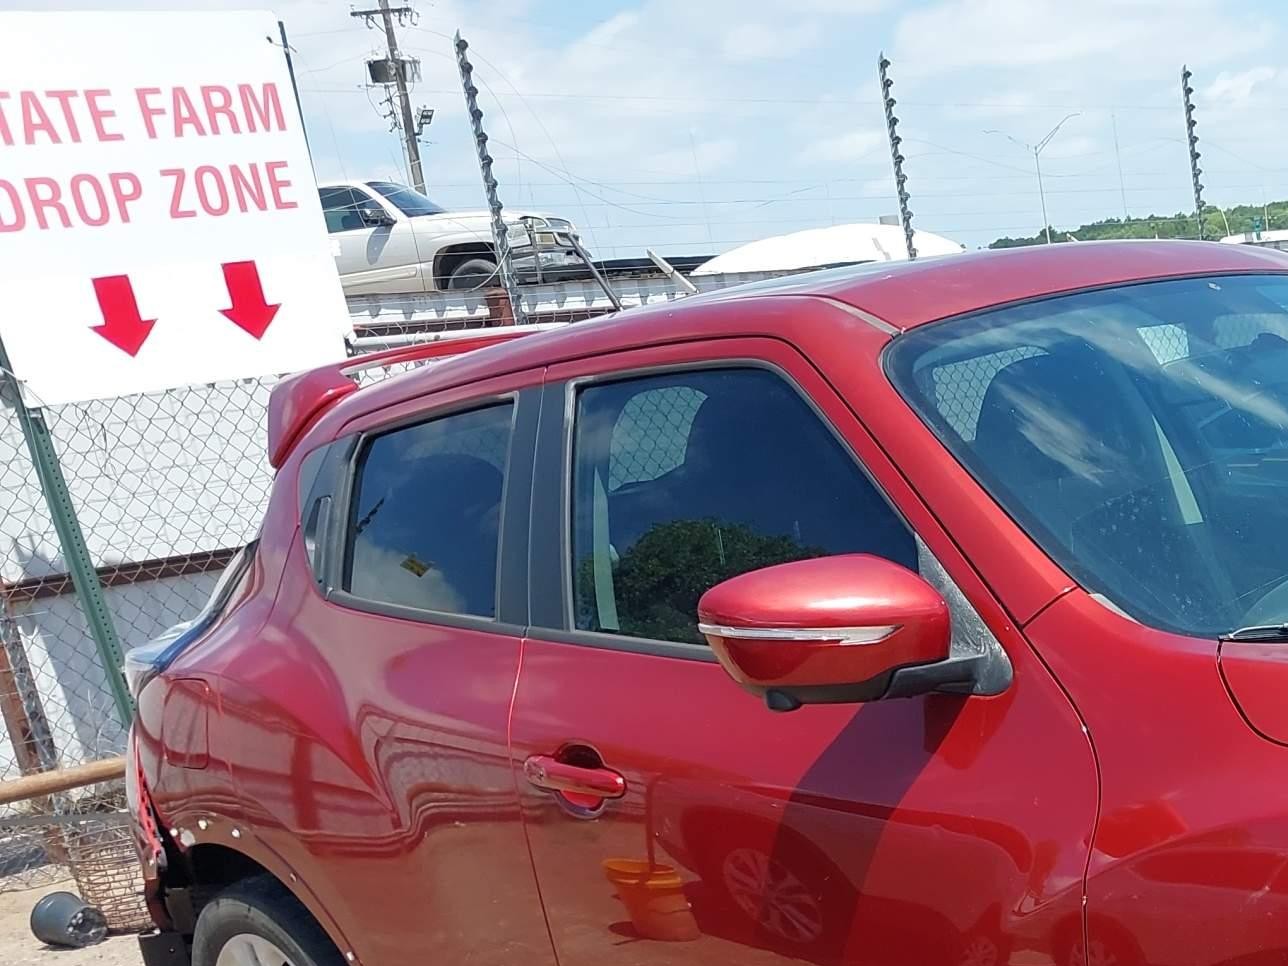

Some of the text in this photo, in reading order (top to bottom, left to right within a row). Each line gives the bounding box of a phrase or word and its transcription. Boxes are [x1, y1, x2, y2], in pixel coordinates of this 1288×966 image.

[134, 83, 287, 139] FARM
[0, 161, 298, 233] DROP ZONE
